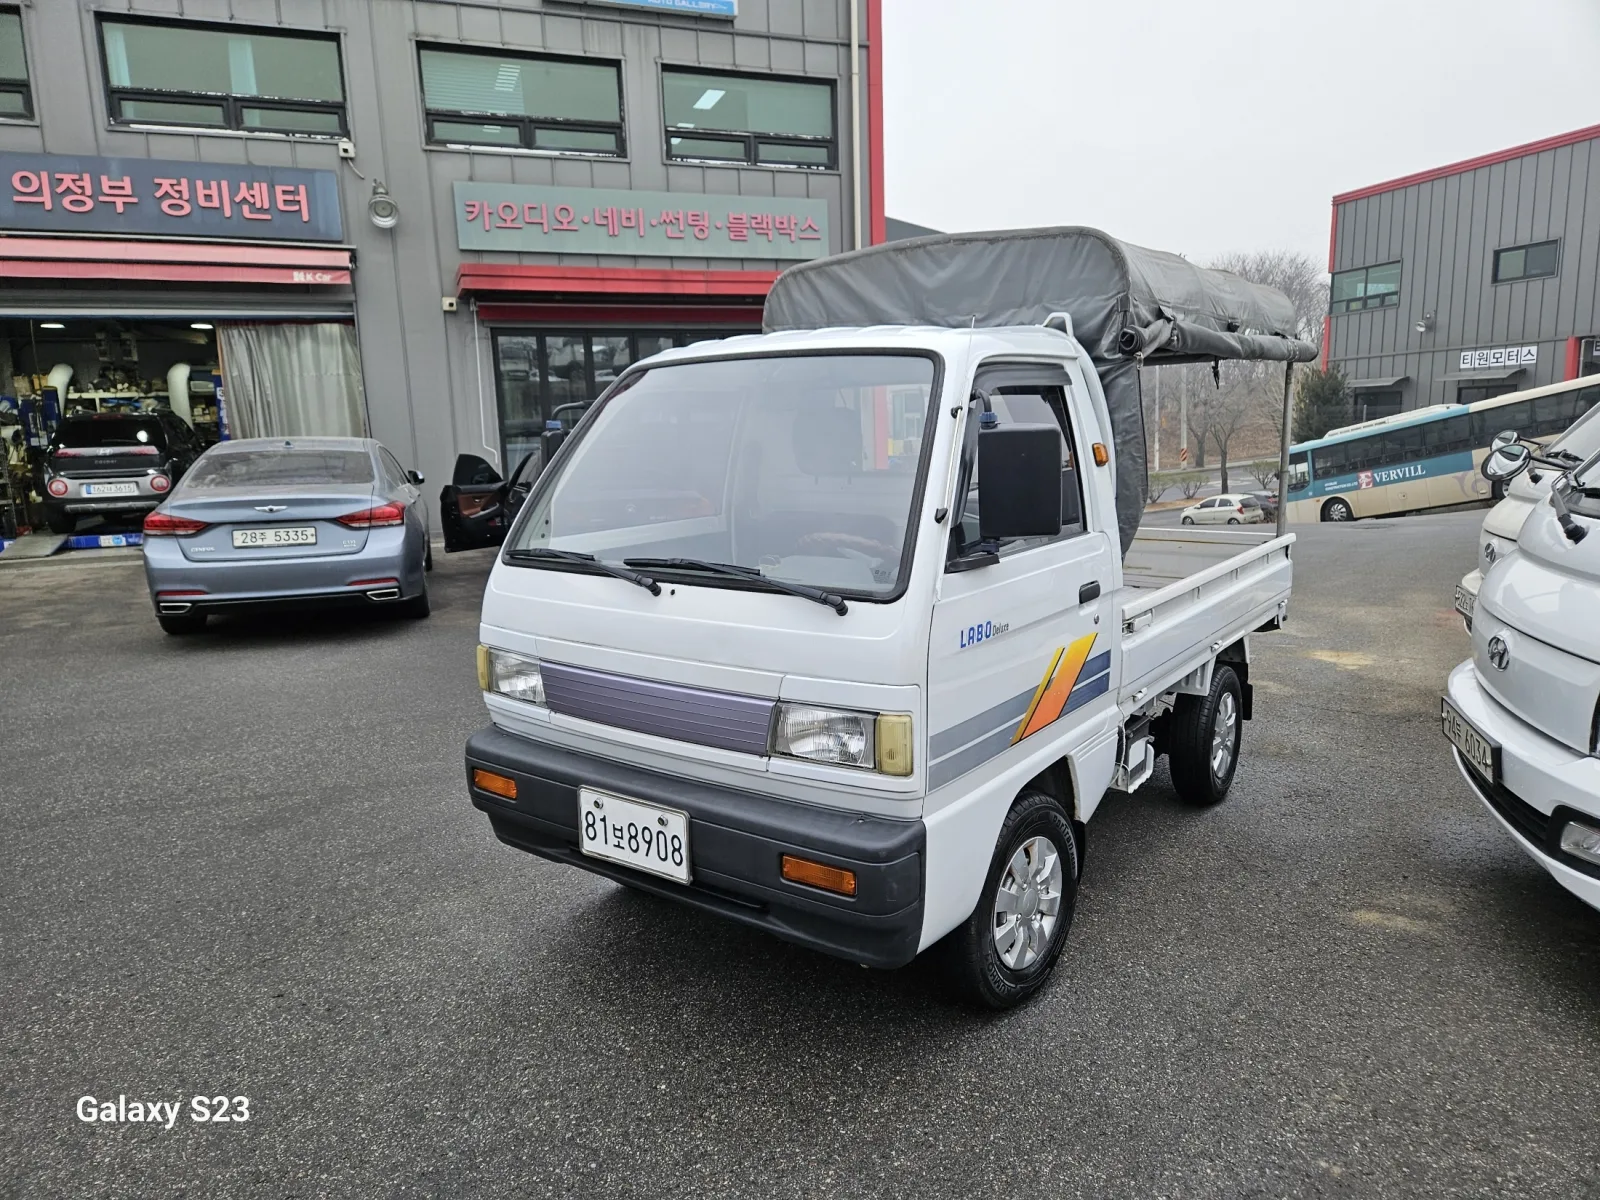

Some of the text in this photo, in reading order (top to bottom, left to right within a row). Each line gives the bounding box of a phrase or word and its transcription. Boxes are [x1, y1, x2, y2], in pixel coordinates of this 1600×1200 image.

[11, 170, 310, 223] 의정부 정비센터
[1462, 348, 1536, 366] 티원모터스
[241, 530, 309, 544] 28주 5335
[960, 620, 992, 649] LABO
